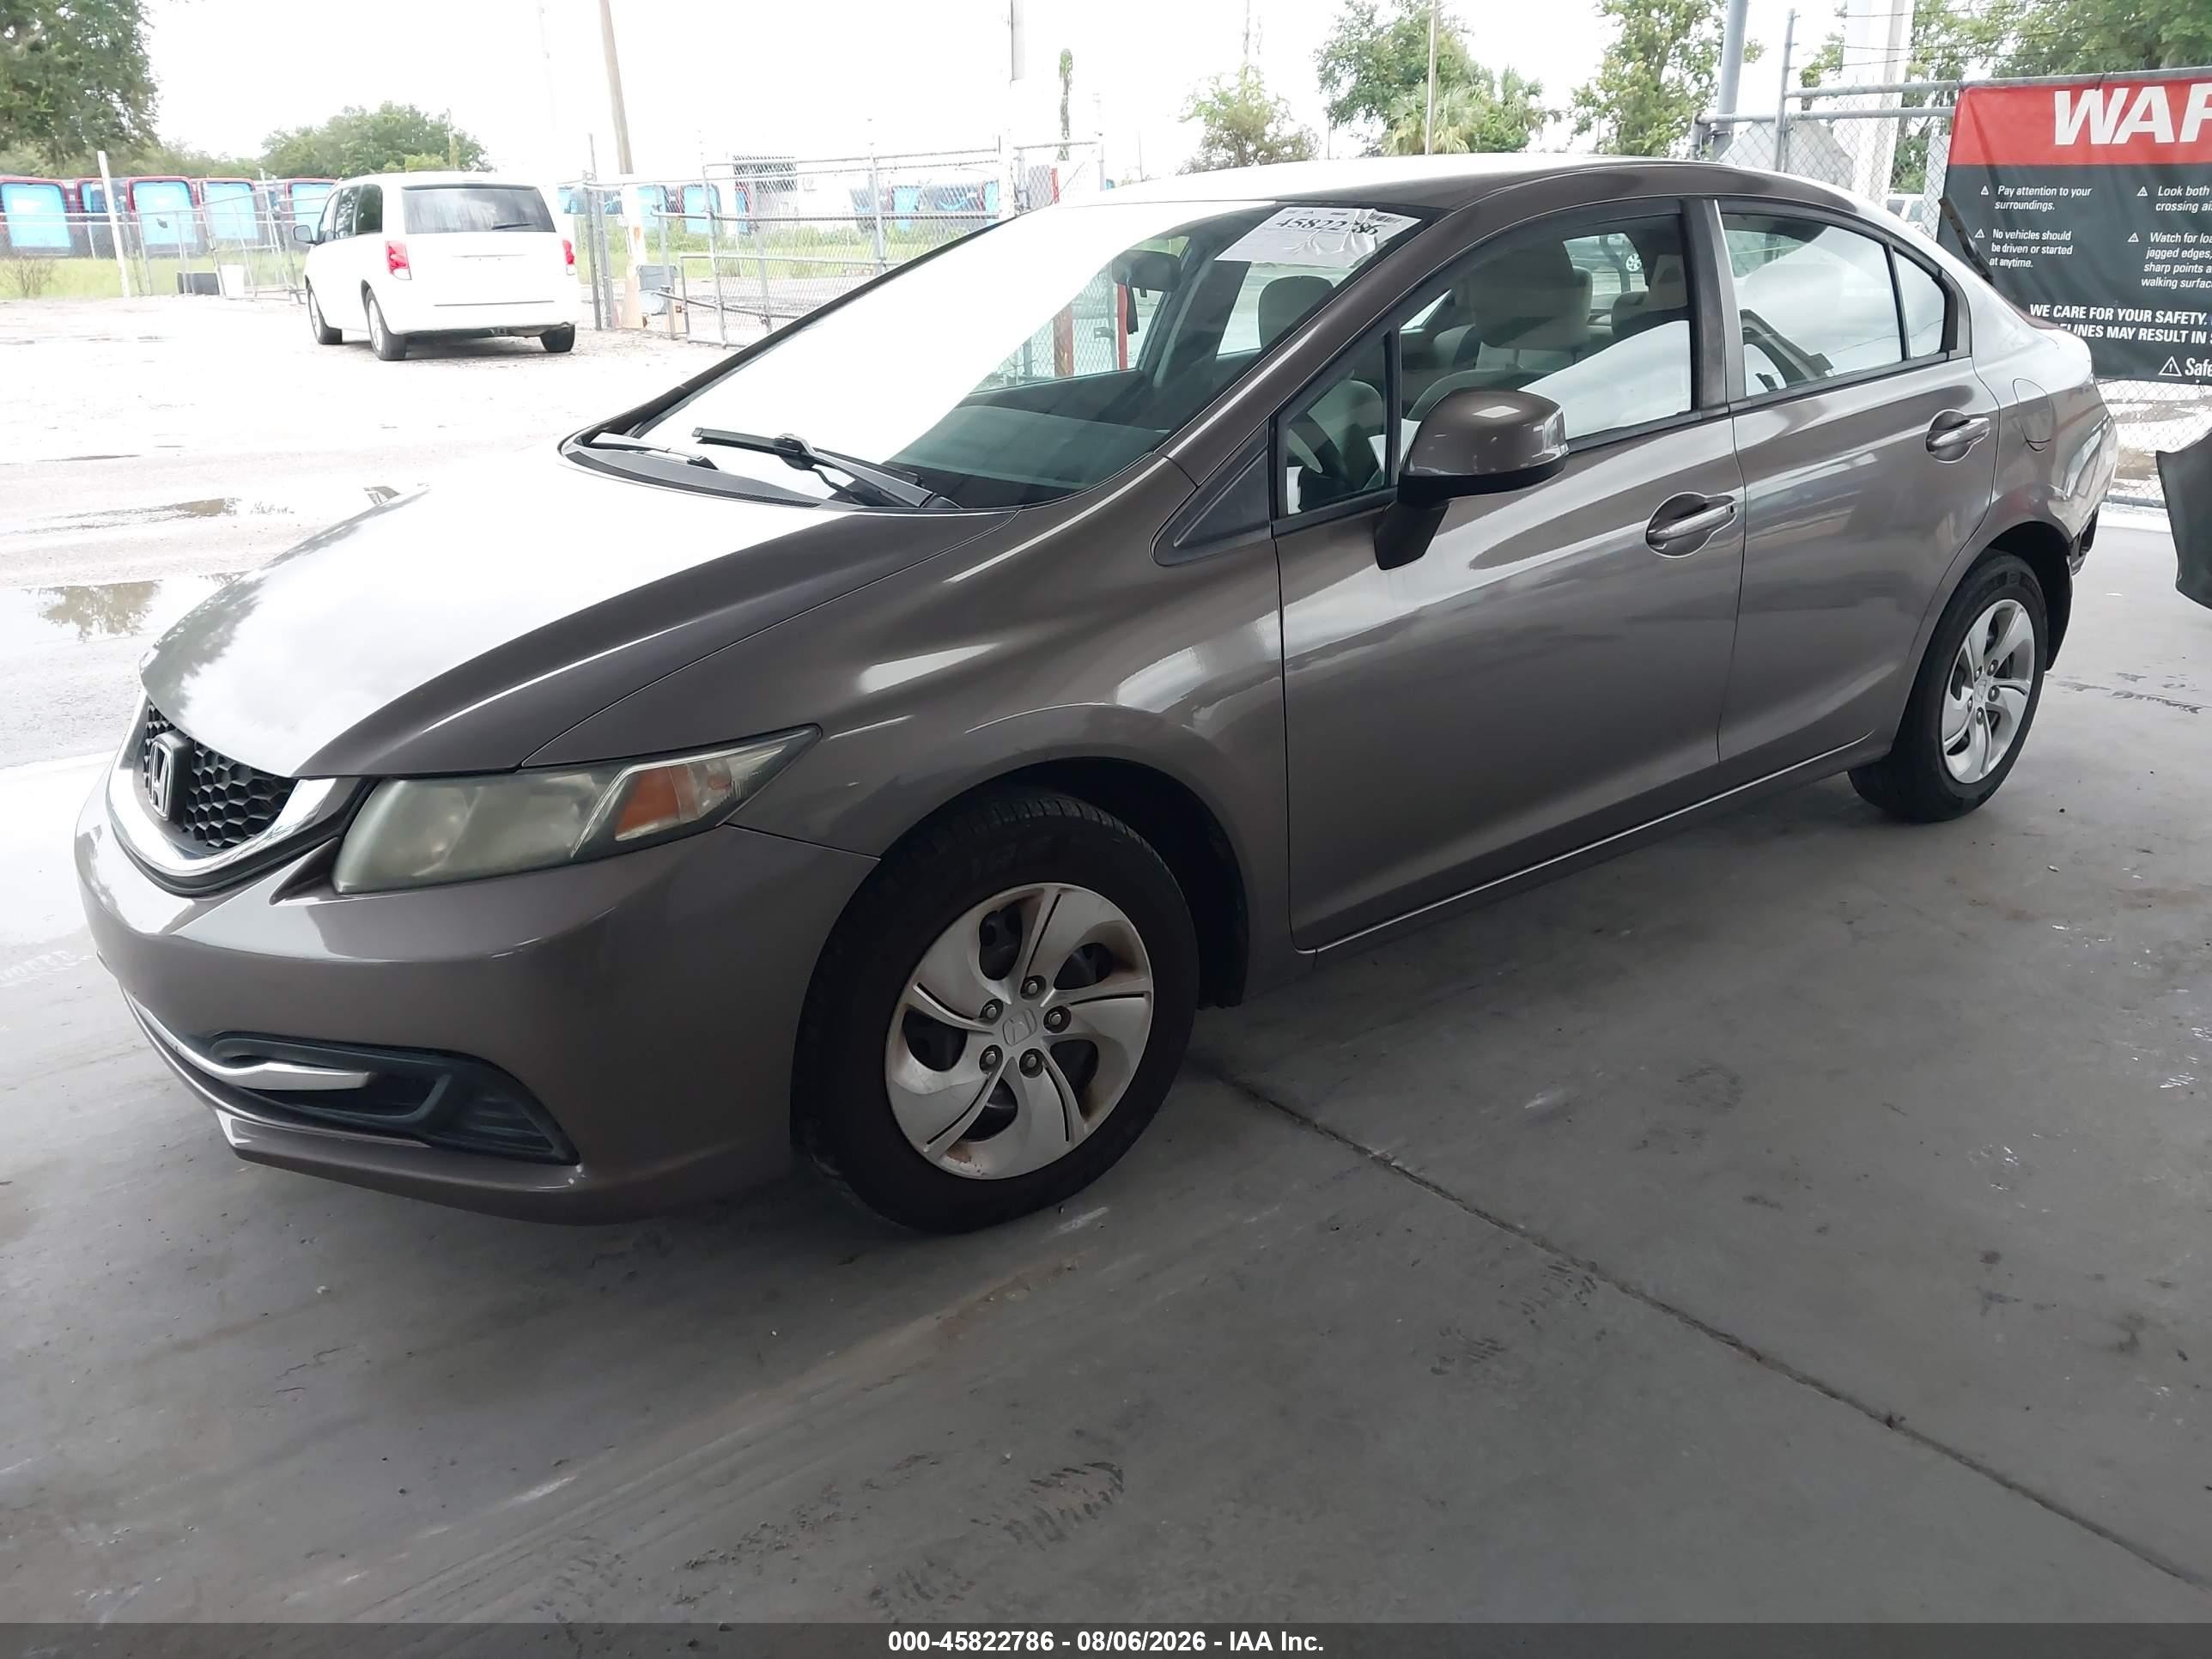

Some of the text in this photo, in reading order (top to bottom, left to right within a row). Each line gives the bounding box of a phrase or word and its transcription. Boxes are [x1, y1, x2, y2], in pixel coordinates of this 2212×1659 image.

[1997, 185, 2093, 198] Pay attention to your
[2158, 185, 2209, 197] Look both
[1994, 200, 2055, 212] surroundings.
[2155, 200, 2199, 214] crossing
[1992, 228, 2072, 241] No vehicles should
[2149, 233, 2182, 243] Watch
[2184, 232, 2198, 244] for
[1991, 242, 2074, 255] be driven or started
[2145, 246, 2212, 261] jagged edges,
[1989, 257, 2034, 269] at anytime.
[2143, 262, 2172, 274] sharp
[2172, 263, 2203, 275] points
[2141, 276, 2179, 289] walking
[2029, 304, 2051, 318] WE
[2053, 305, 2087, 319] CARE
[2088, 307, 2113, 321] FOR
[2117, 308, 2153, 323] YOUR
[2154, 310, 2208, 325] SAFETY.
[2106, 325, 2137, 340] MAY
[2137, 328, 2190, 343] RESULT
[2191, 331, 2208, 344] IN
